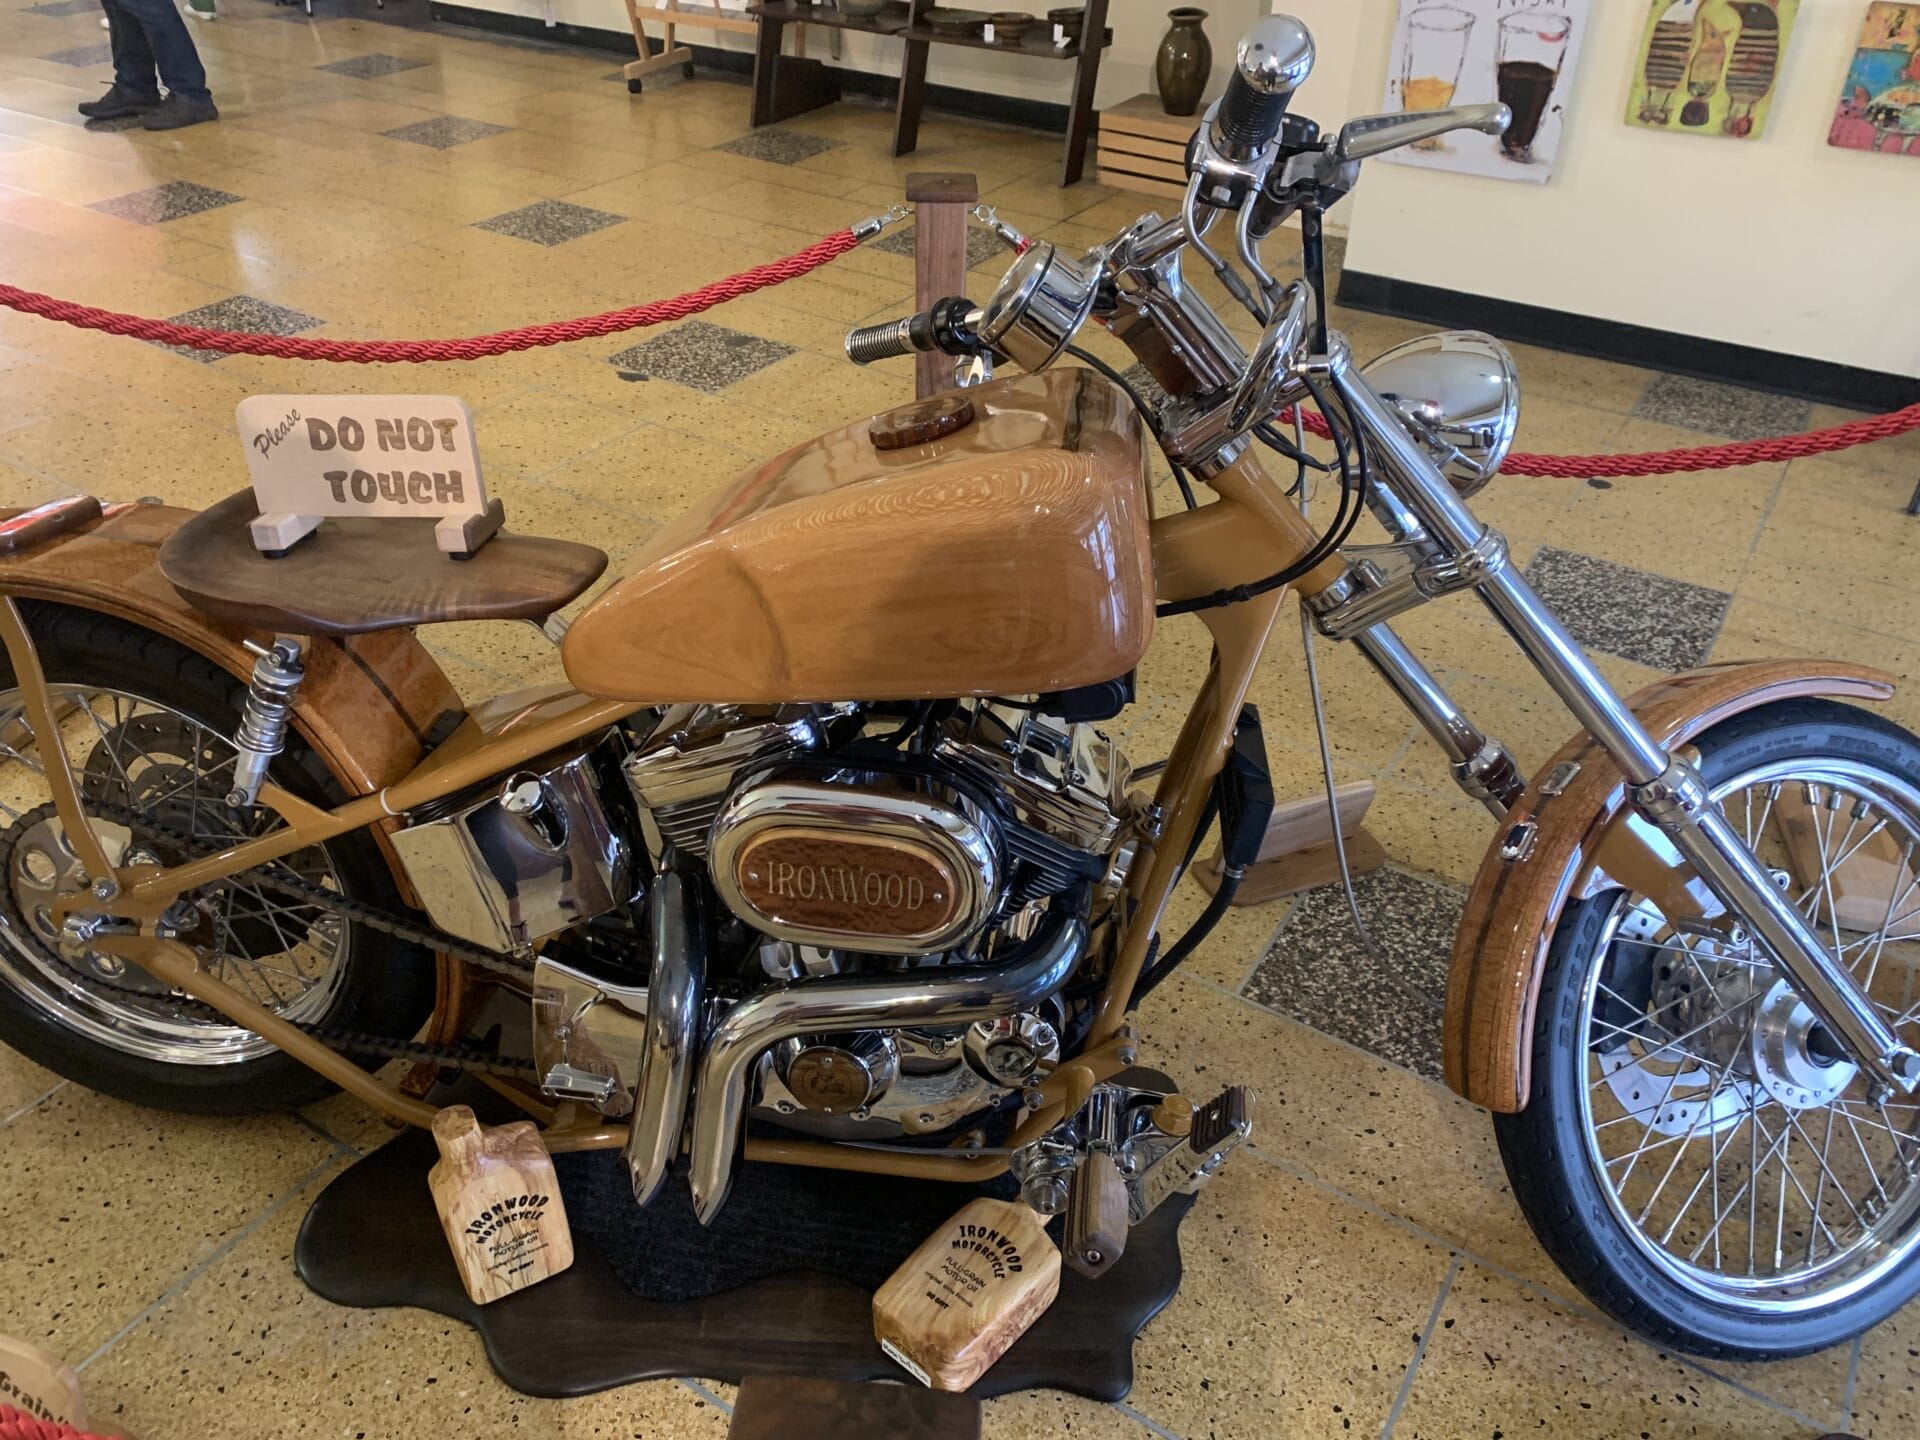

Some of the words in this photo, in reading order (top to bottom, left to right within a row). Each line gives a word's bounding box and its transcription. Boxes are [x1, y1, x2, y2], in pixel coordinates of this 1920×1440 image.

[253, 408, 301, 460] Please
[304, 416, 365, 451] DO
[375, 416, 458, 452] NOT
[323, 469, 465, 504] TOUCH
[767, 861, 924, 910] IRONWOOD
[465, 1194, 549, 1235] IRONWOOD
[475, 1210, 544, 1244] MOTORCYCLE
[493, 1240, 525, 1257] MOTOR
[951, 1239, 1005, 1279] MOTORCYCLE
[959, 1224, 1022, 1272] IRONWOOD
[940, 1264, 968, 1285] MOTOR
[945, 1256, 987, 1288] FULL-GRAIN
[0, 1371, 69, 1424] Grain
